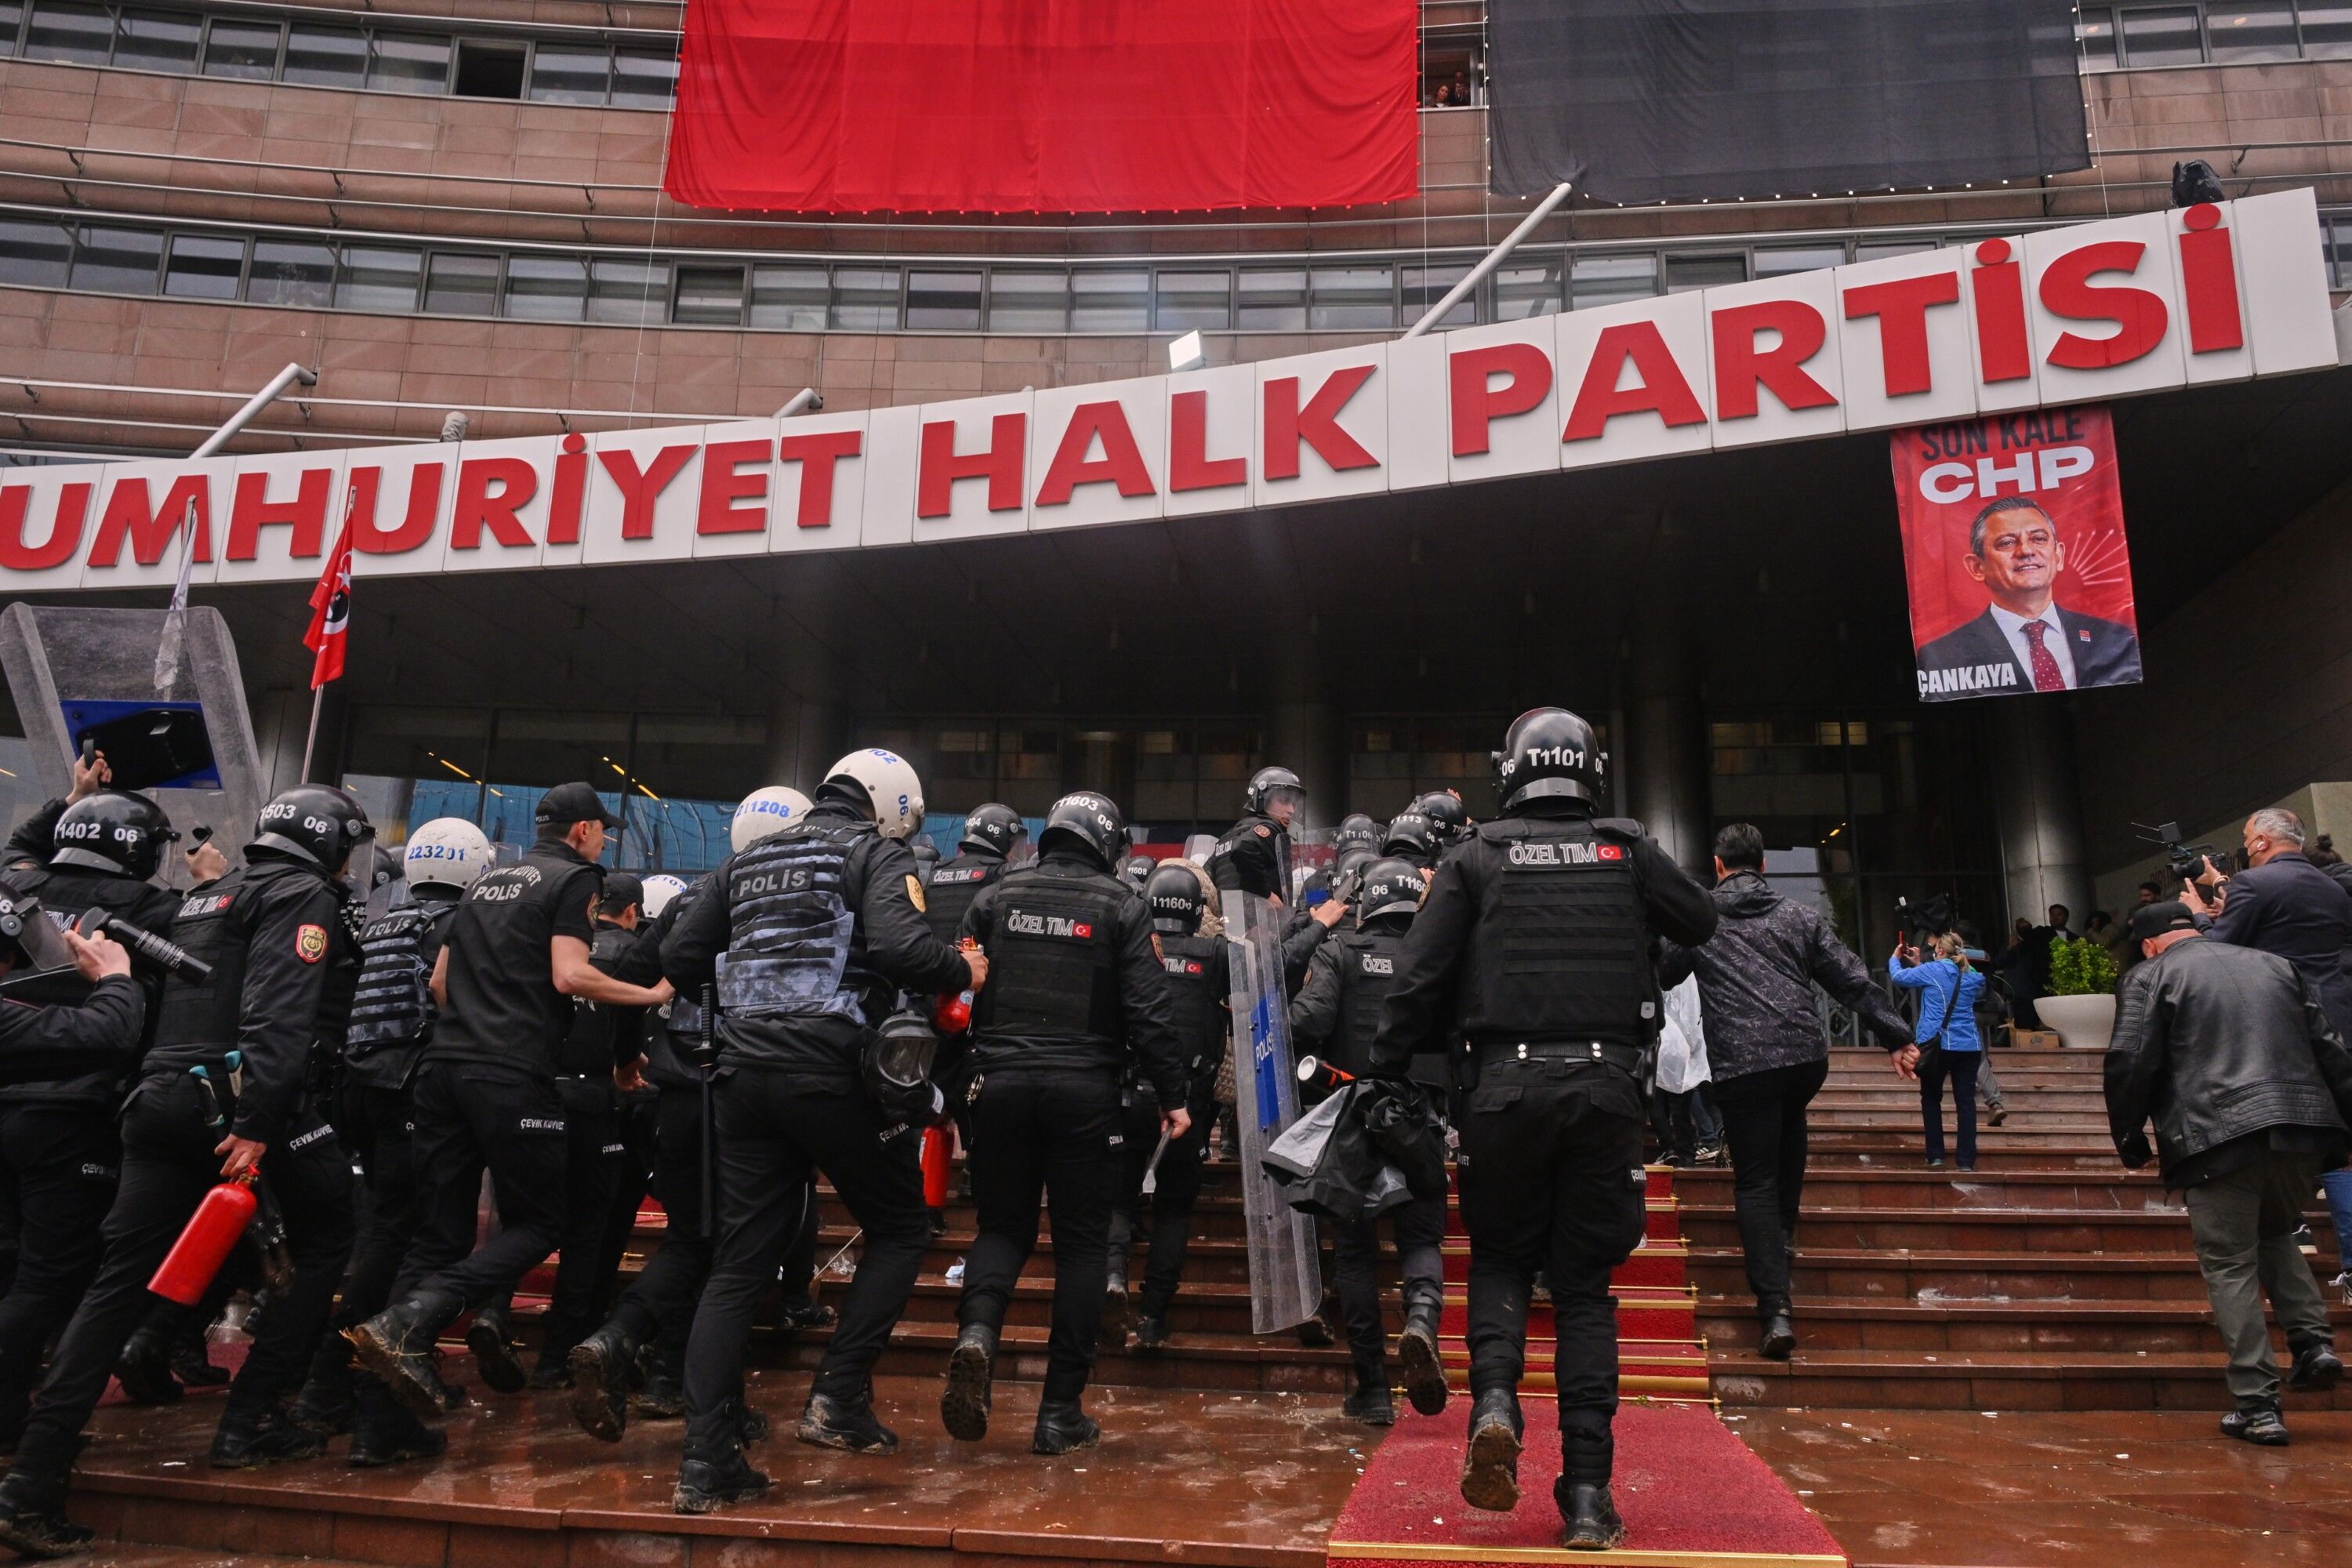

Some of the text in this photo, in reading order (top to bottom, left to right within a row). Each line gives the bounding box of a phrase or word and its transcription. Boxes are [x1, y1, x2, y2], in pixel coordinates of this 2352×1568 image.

[917, 364, 1381, 519] HALK
[1450, 201, 2244, 459] PARTİSİ
[1921, 404, 2085, 461] SON KALE
[1919, 445, 2095, 504] CHP
[1916, 662, 2017, 698] ÇANKAYA
[1501, 758, 1515, 776] 06
[1526, 746, 1584, 769] T1101
[303, 816, 328, 833] 06
[987, 824, 1000, 835] 06
[1098, 814, 1113, 831] 06
[1434, 819, 1446, 829] 06
[114, 828, 138, 843] 06
[1426, 831, 1436, 843] 06
[1509, 840, 1560, 865] ÖZEL
[1372, 884, 1388, 895] 06
[1008, 909, 1045, 935] ÖZEL
[1363, 953, 1394, 975] ÖZEL
